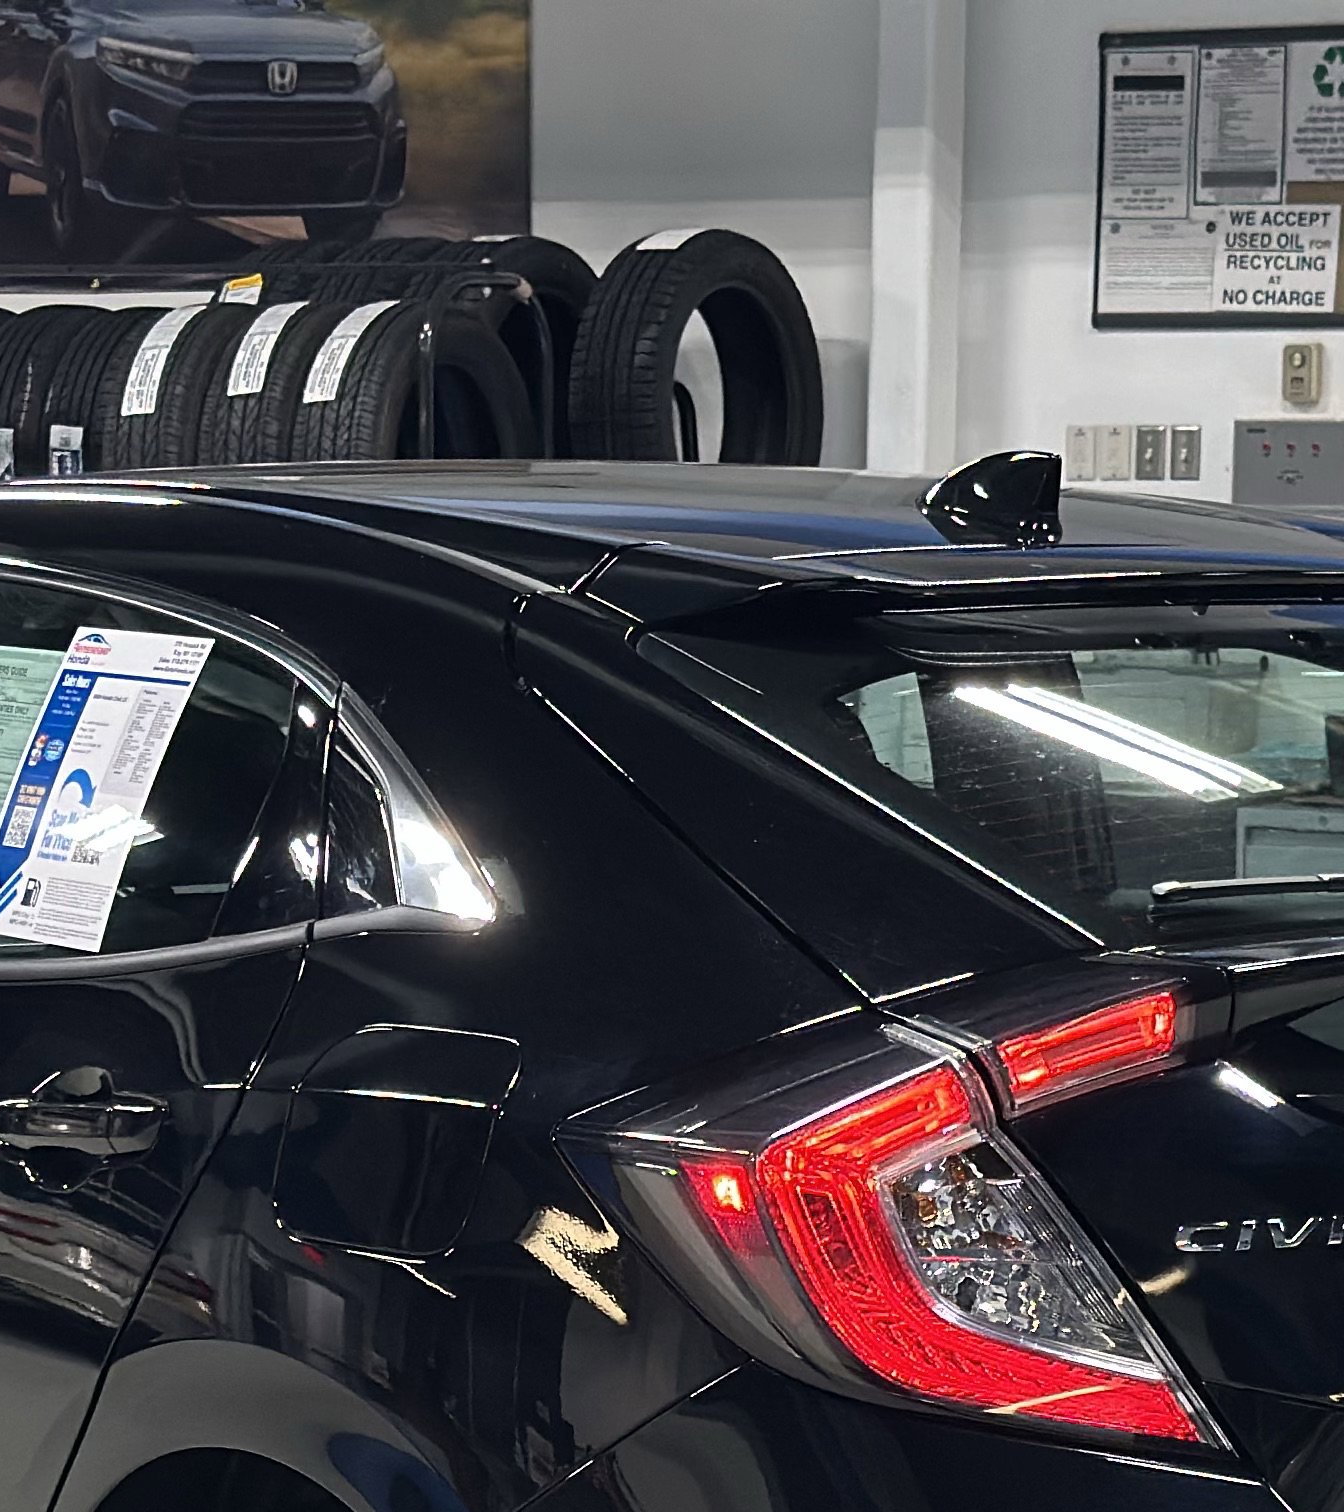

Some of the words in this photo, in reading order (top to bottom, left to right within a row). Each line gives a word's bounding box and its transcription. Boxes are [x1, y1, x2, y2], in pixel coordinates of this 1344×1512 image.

[1229, 211, 1256, 227] WE
[1260, 211, 1332, 228] ACCEPT
[1224, 232, 1272, 249] USED
[1276, 232, 1305, 250] OIL
[1308, 239, 1333, 250] FOR
[1226, 255, 1327, 272] RECYCLING
[1268, 275, 1282, 285] AT
[1222, 288, 1248, 306] NO
[1256, 289, 1326, 307] CHARGE
